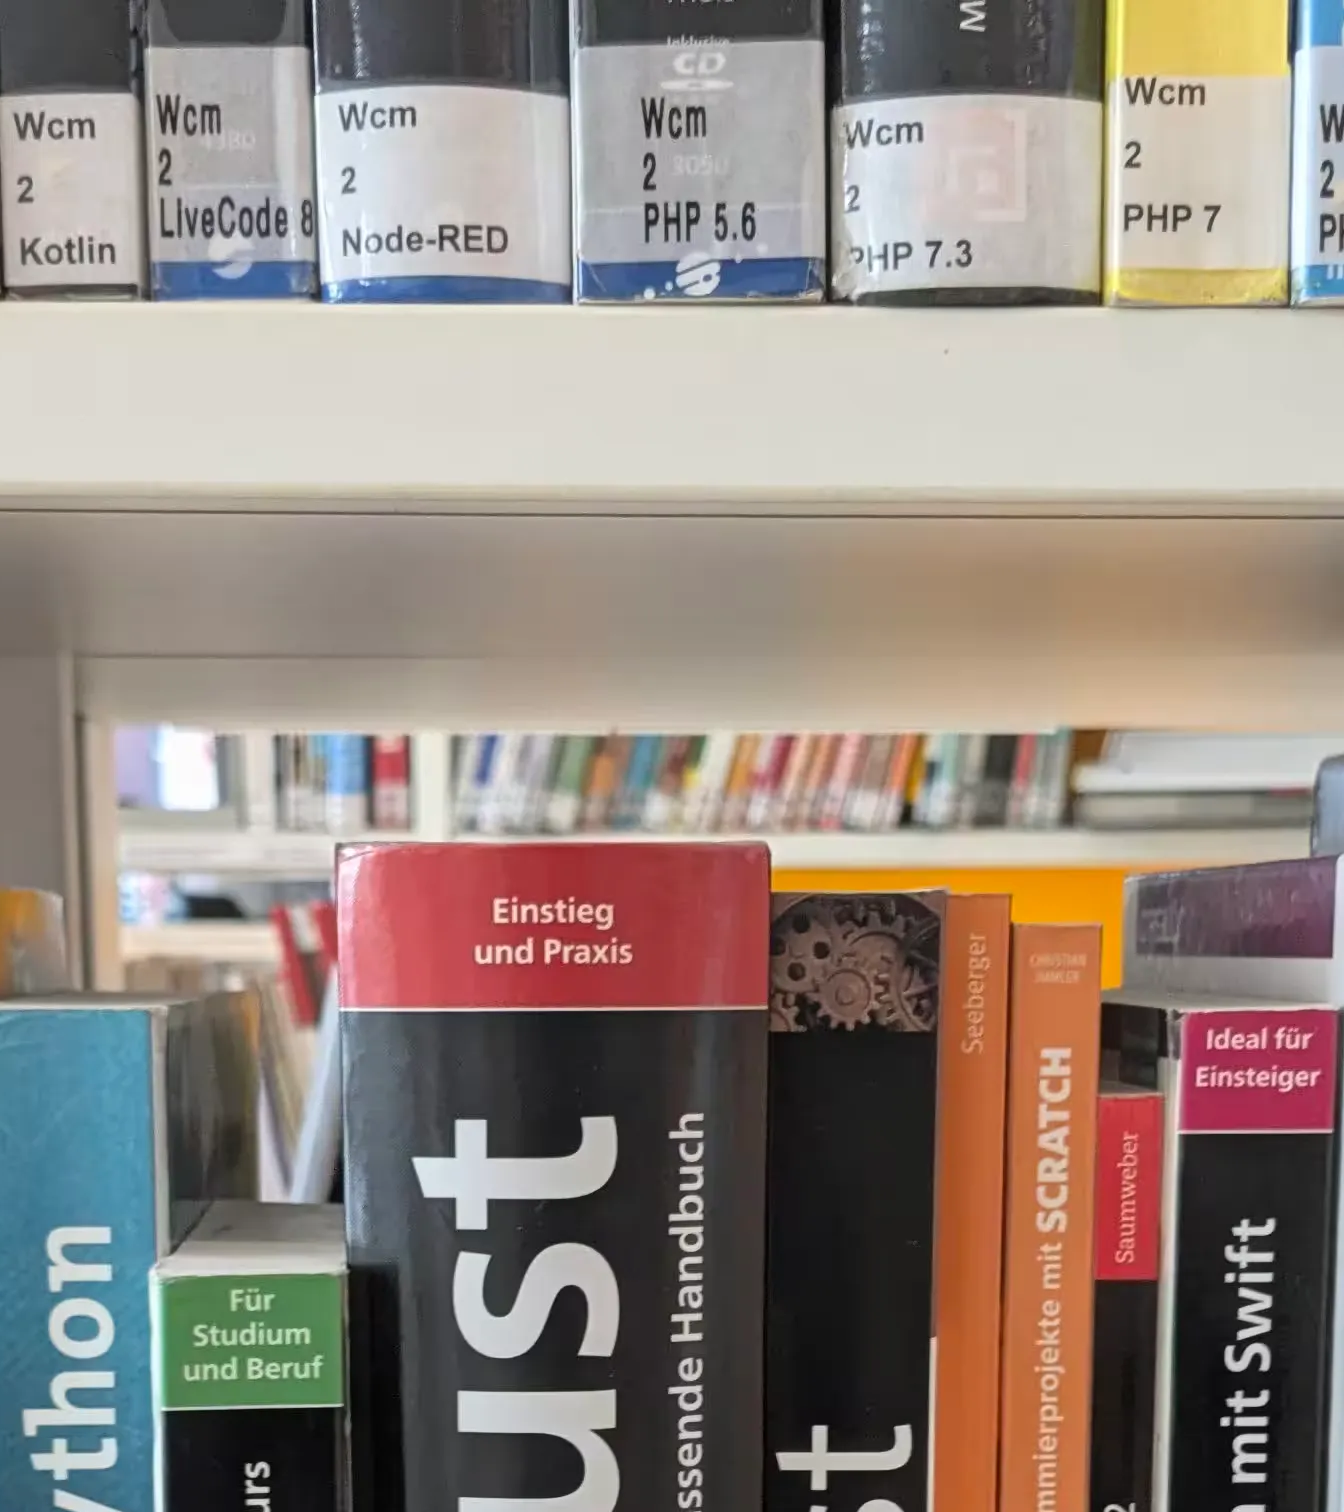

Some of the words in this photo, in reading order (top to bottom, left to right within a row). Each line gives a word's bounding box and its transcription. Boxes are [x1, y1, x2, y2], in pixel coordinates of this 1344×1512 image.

[157, 94, 222, 135] Wcm
[159, 198, 289, 240] LiveCode
[300, 204, 314, 237] 8
[644, 202, 702, 243] PHP
[714, 201, 757, 243] 5.6
[1123, 204, 1192, 233] PHP
[1202, 204, 1221, 232] 7
[20, 235, 116, 267] Kotlin
[341, 226, 509, 256] Node-RED
[491, 896, 615, 931] Einstieg
[474, 939, 535, 965] und
[543, 938, 634, 966] Praxis
[960, 932, 991, 1054] Seeberger
[1204, 1027, 1269, 1050] Ideal
[1274, 1027, 1313, 1050] für
[1194, 1064, 1322, 1092] Einsteiger
[1035, 1046, 1073, 1233] SCRATCH
[1115, 1130, 1139, 1264] Saumweber
[667, 1111, 706, 1344] Handbuch
[1029, 1240, 1064, 1287] mit
[229, 1288, 276, 1313] Für
[1223, 1216, 1277, 1373] Swift
[192, 1321, 312, 1348] Studium
[182, 1359, 240, 1383] und
[246, 1355, 323, 1382] Beruf
[1219, 1387, 1272, 1487] mit
